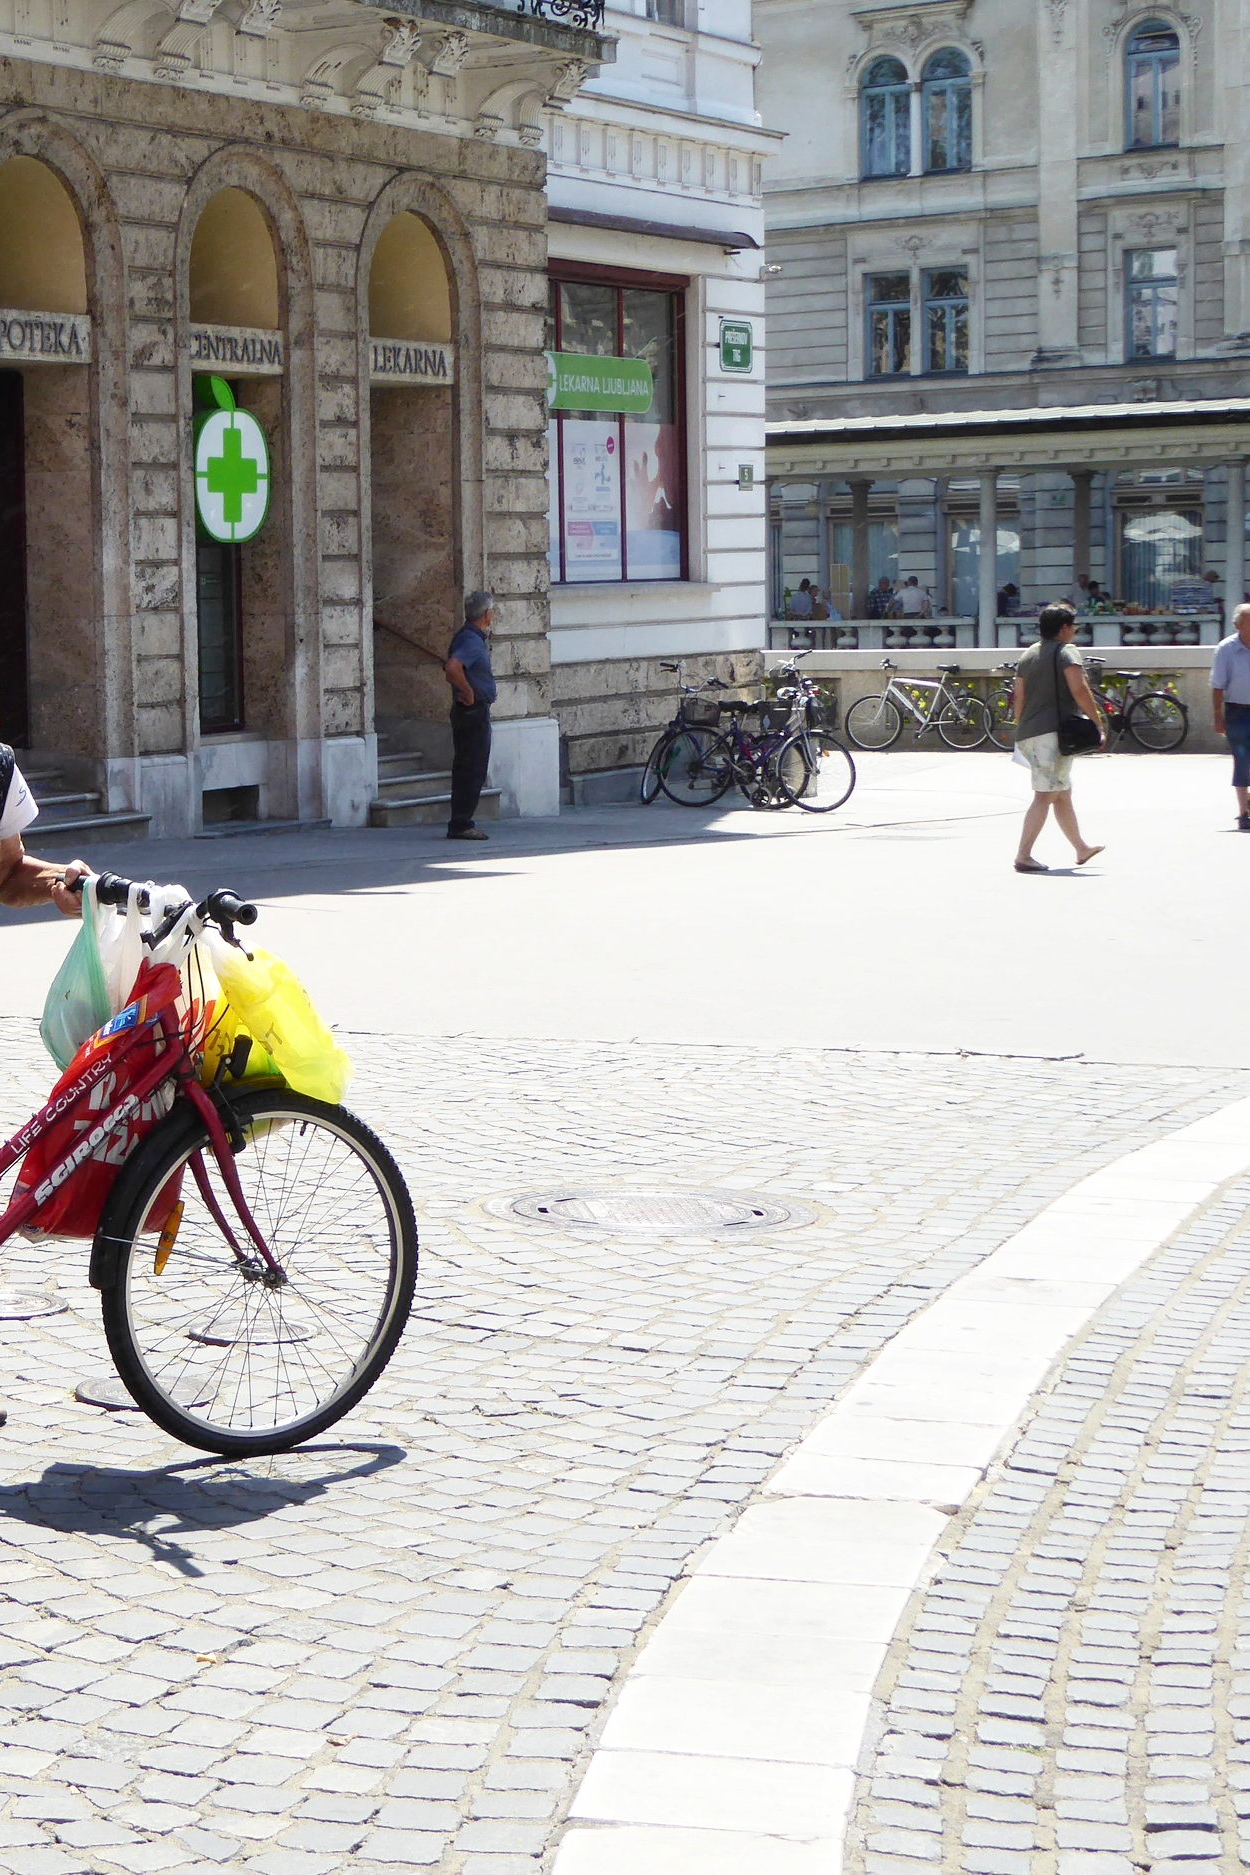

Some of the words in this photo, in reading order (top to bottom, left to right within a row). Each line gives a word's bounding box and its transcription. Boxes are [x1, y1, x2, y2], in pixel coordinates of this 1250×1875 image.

[373, 345, 447, 377] LEKARNA
[559, 374, 600, 393] LEKARNA
[602, 377, 648, 397] LJUBLJANA
[10, 1120, 42, 1155] LIFE
[46, 1051, 112, 1122] COUNTRY
